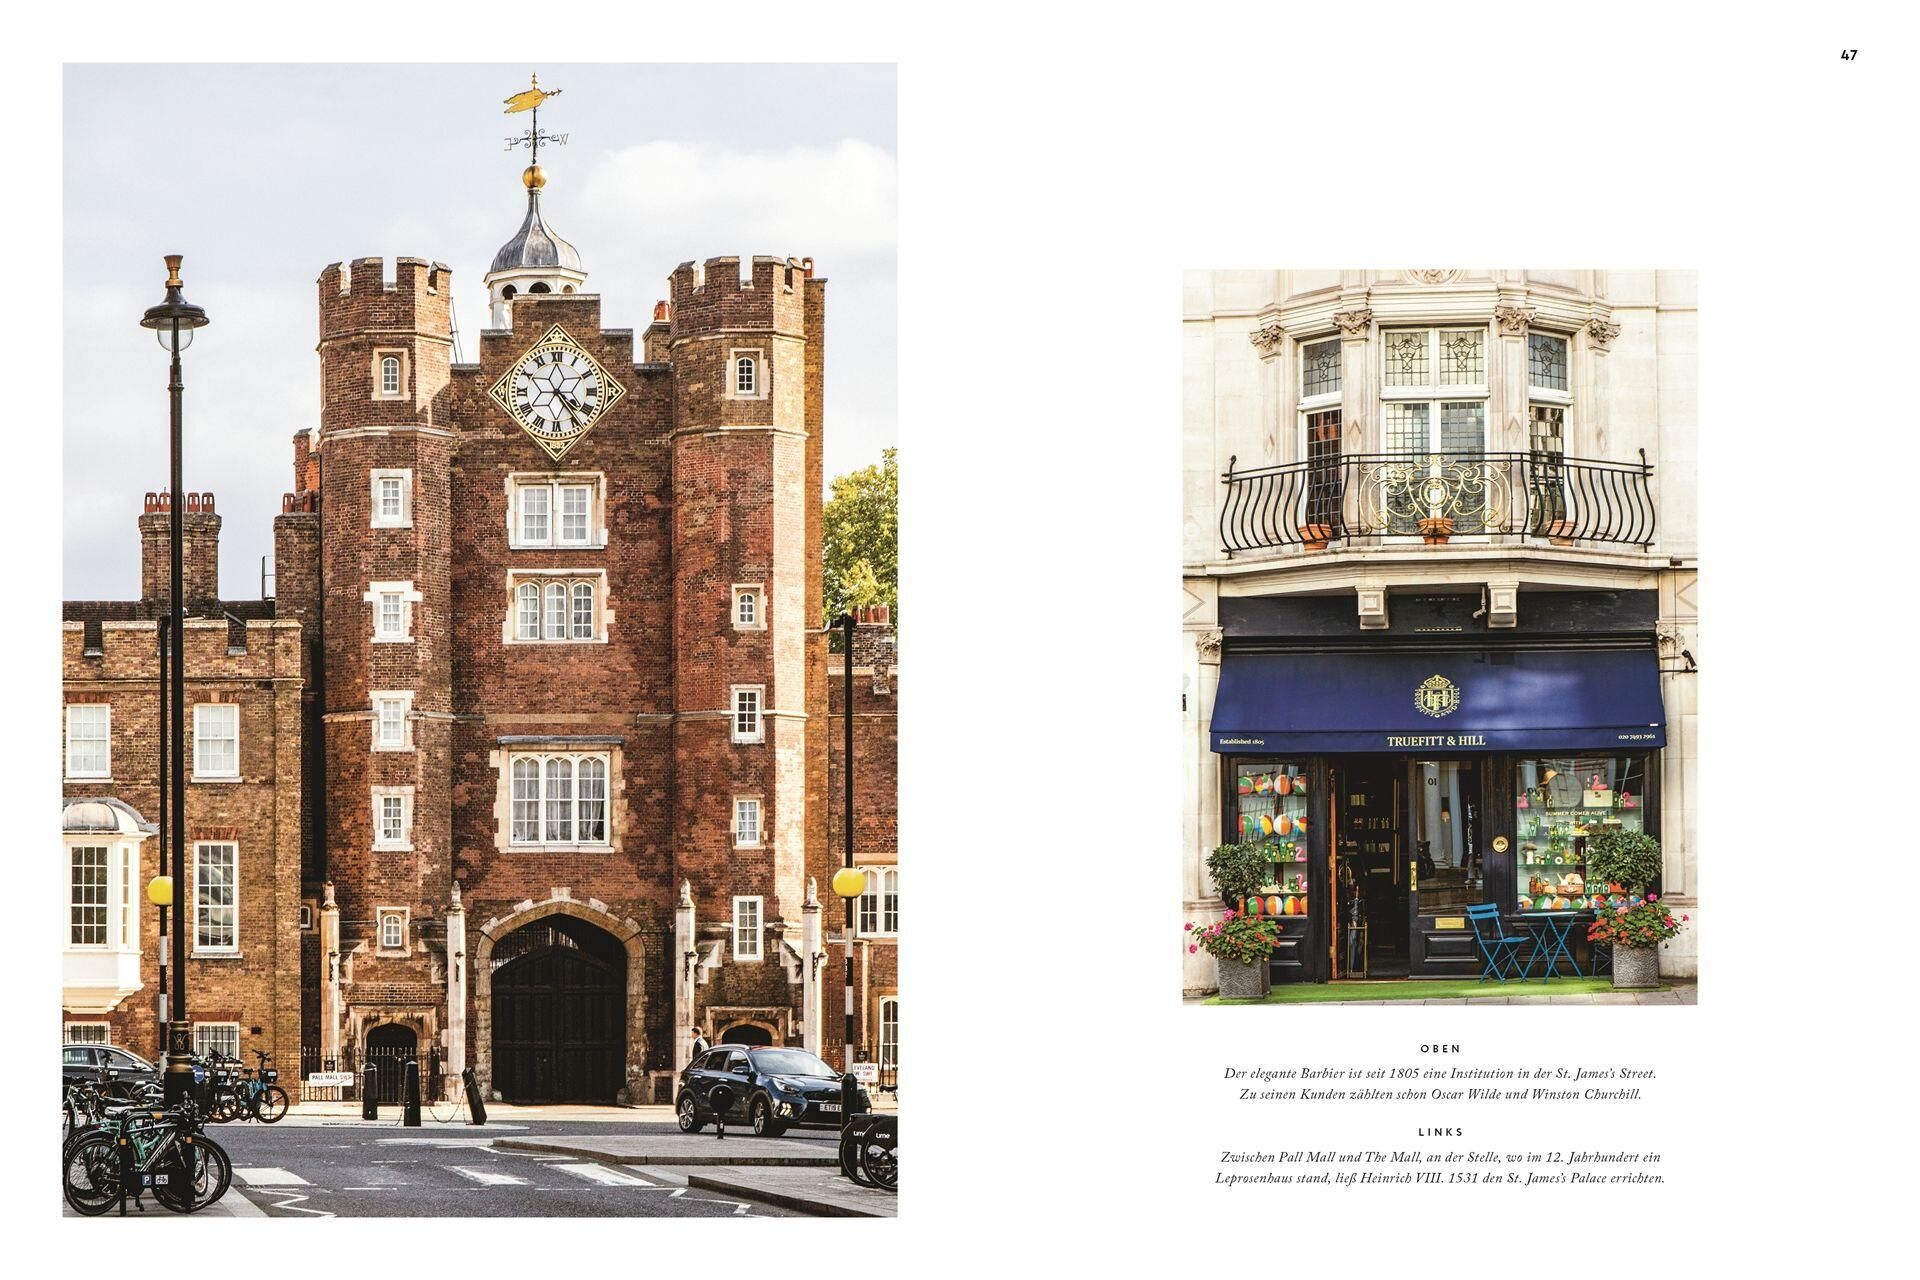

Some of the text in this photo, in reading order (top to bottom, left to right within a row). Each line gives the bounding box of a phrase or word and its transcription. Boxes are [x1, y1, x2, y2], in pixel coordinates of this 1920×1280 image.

[608, 387, 616, 396] R
[1387, 735, 1486, 747] TRUEFITT & HILL
